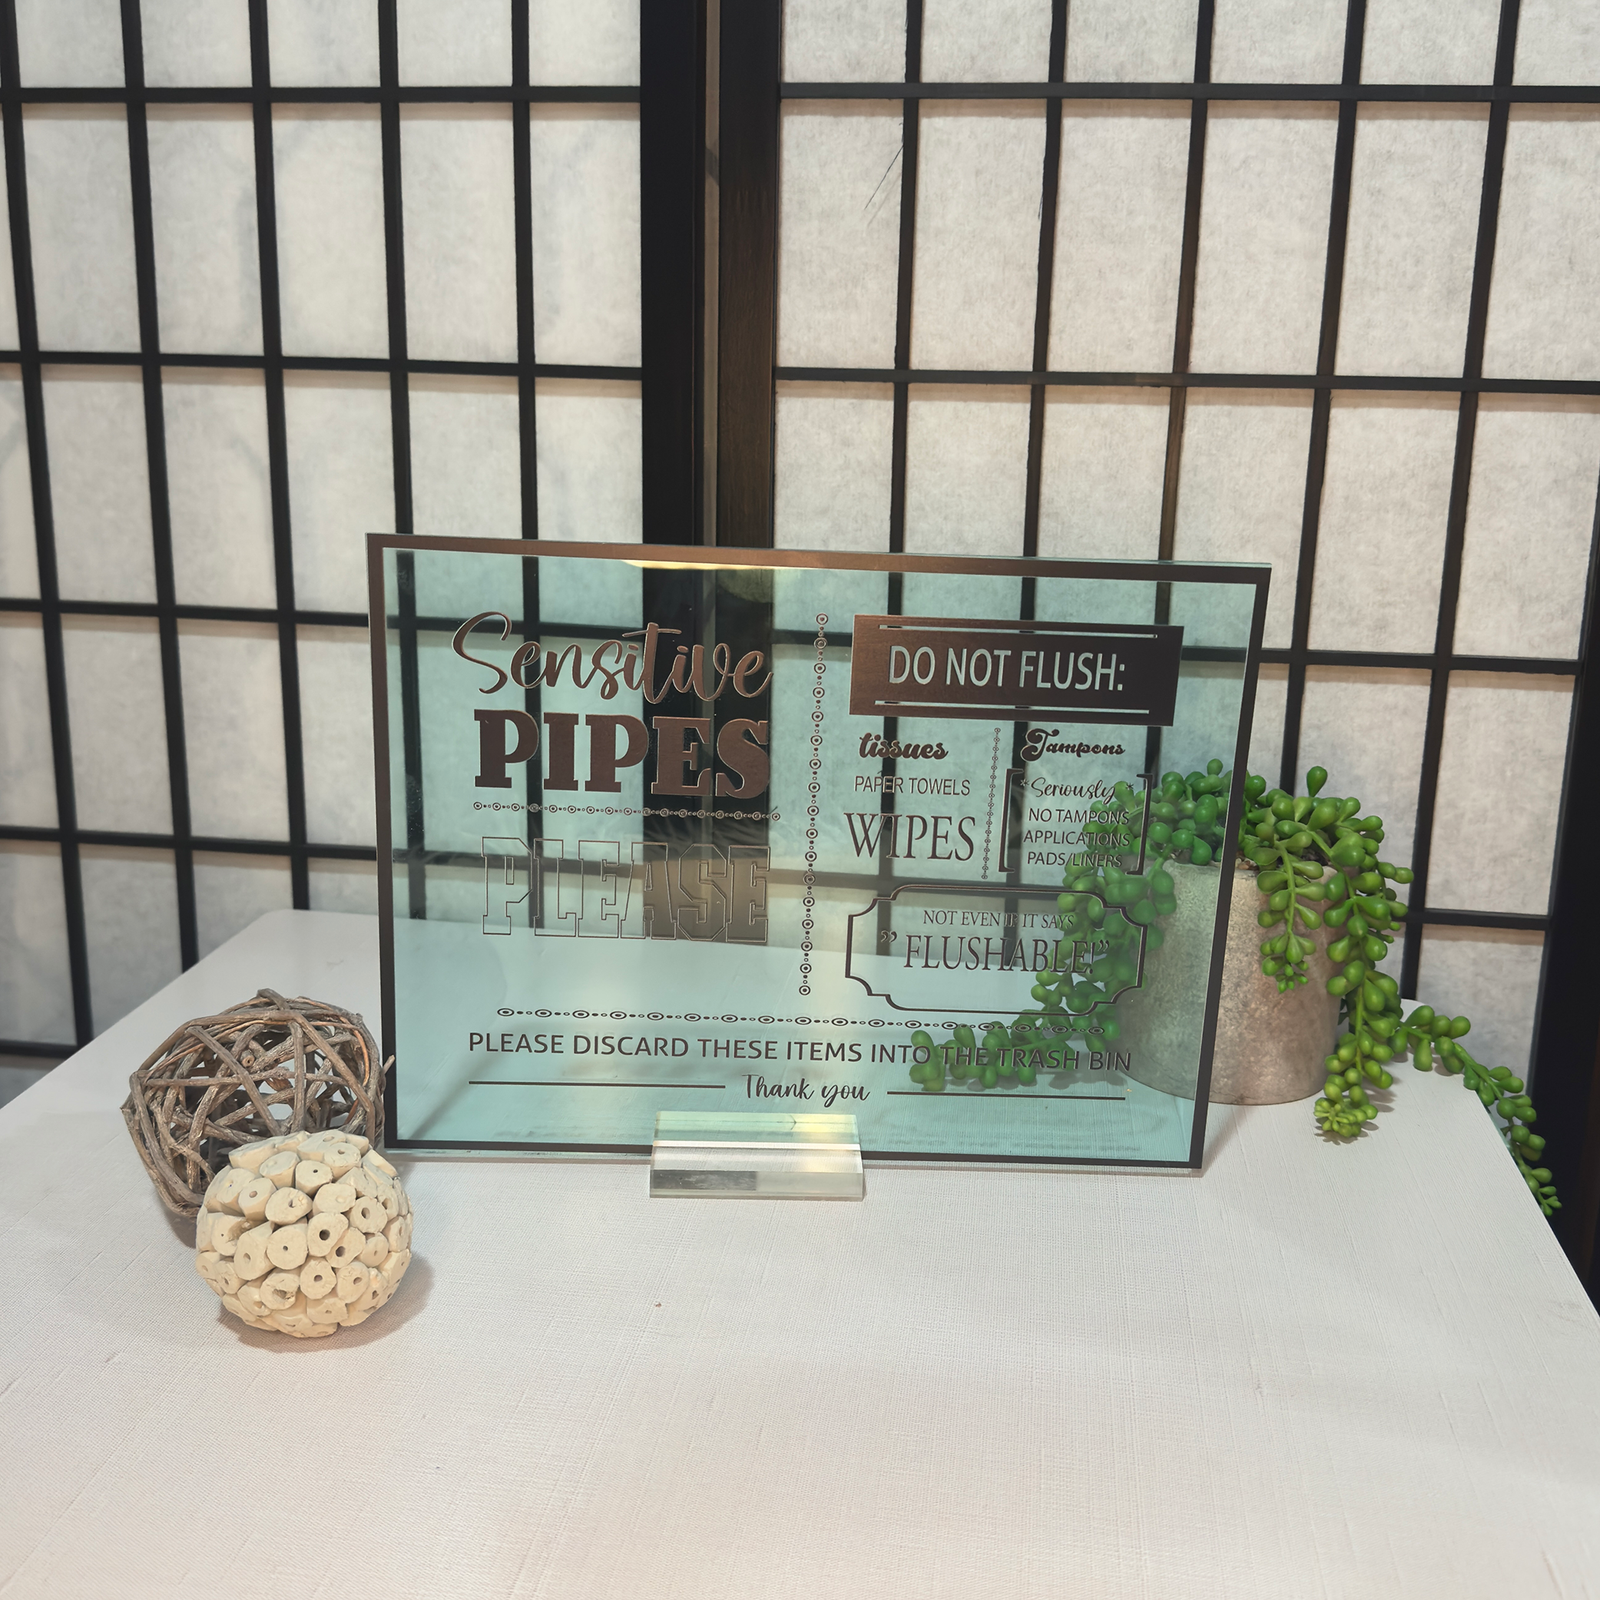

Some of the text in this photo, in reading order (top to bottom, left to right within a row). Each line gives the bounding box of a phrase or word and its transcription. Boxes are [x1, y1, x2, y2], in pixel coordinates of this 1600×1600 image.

[452, 611, 774, 704] Sensitive
[888, 645, 1126, 691] DO NOT FLUSH:
[473, 709, 771, 799] PIPES
[858, 732, 949, 760] tissues
[1020, 728, 1126, 762] Tampons
[854, 775, 971, 796] PAPER TOWELS
[1028, 808, 1130, 825] NO TAMPONS
[843, 812, 976, 861] WIPES
[1023, 830, 1131, 847] APPLICATIONS
[1027, 852, 1123, 868] PADS/LINERS
[481, 836, 771, 943] PLEASE
[923, 910, 1075, 929] NOT EVEN IF IT SAYS
[469, 1032, 1132, 1071] PLEASE DISCARD THESE ITEMS INTO THE TRASH BIN
[741, 1073, 871, 1108] Thank you
